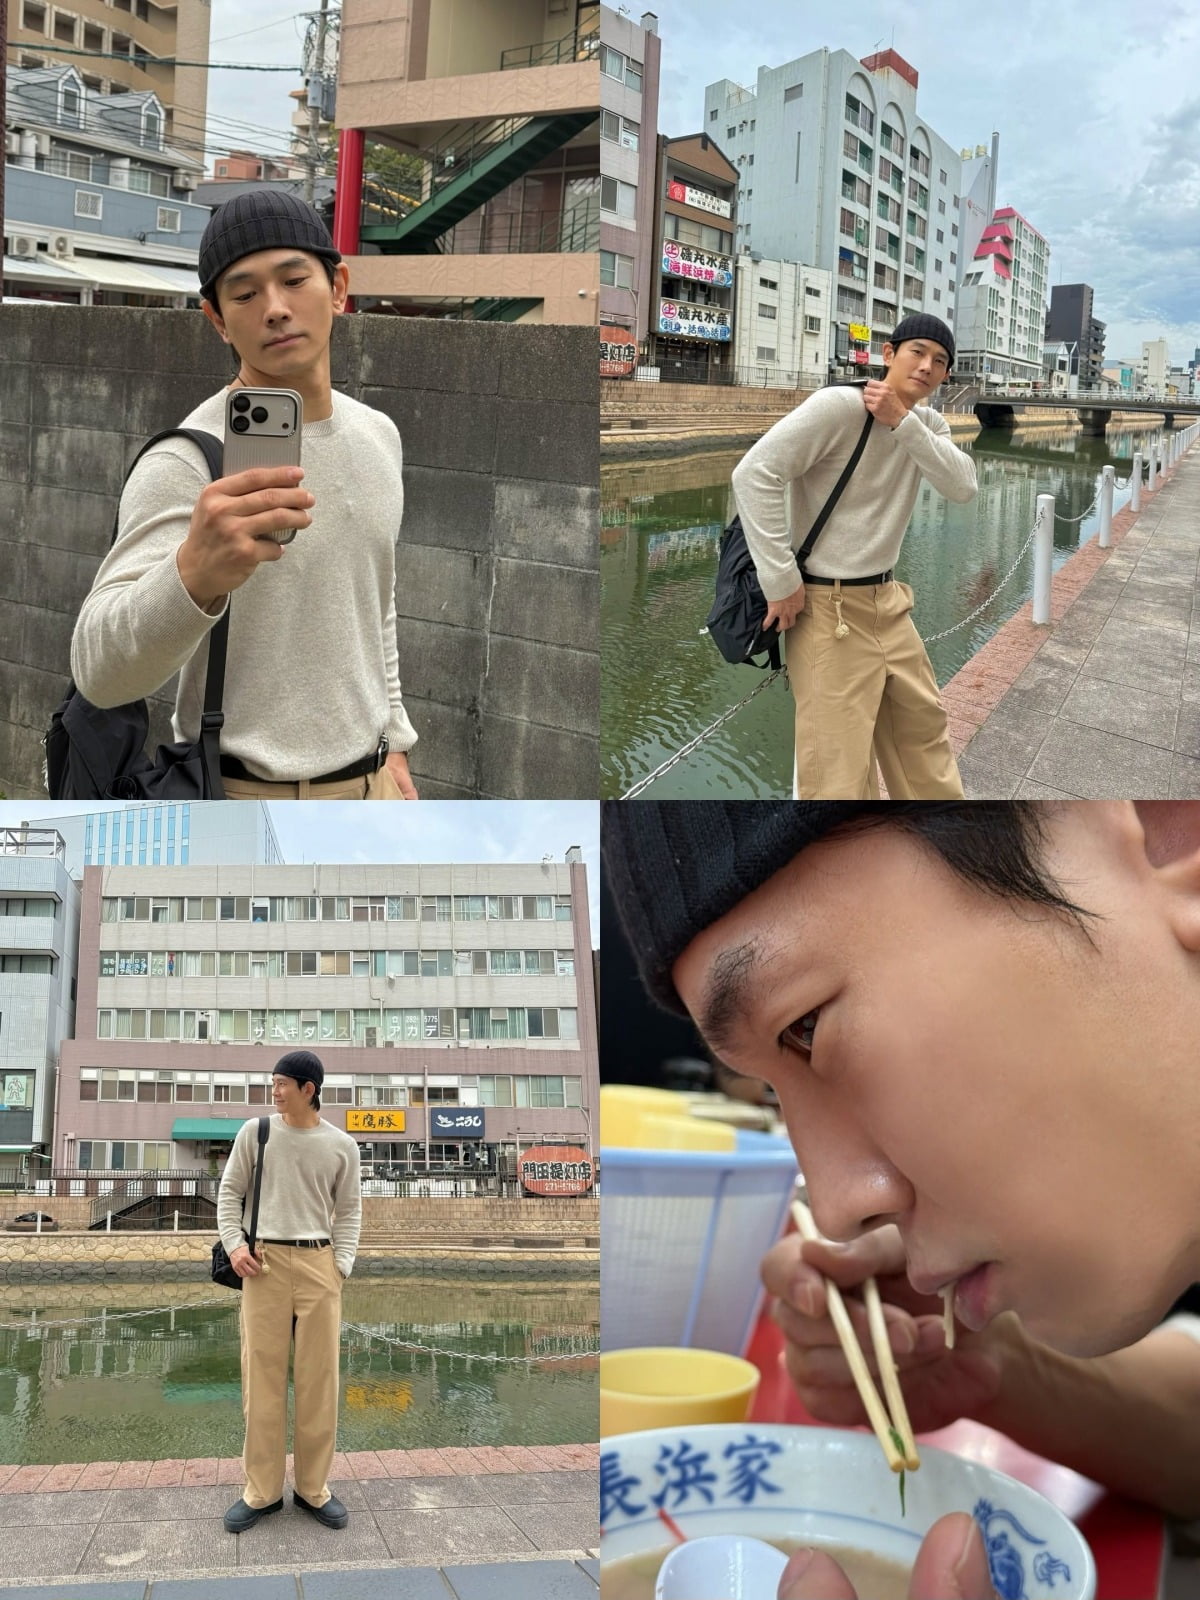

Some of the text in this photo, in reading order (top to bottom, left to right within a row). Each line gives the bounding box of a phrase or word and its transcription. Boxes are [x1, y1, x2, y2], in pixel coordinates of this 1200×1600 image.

[680, 247, 730, 272] 磯丸水産
[678, 306, 728, 326] 磯丸水産
[389, 1024, 470, 1037] アカデミー
[600, 1434, 783, 1524] 長浜家
